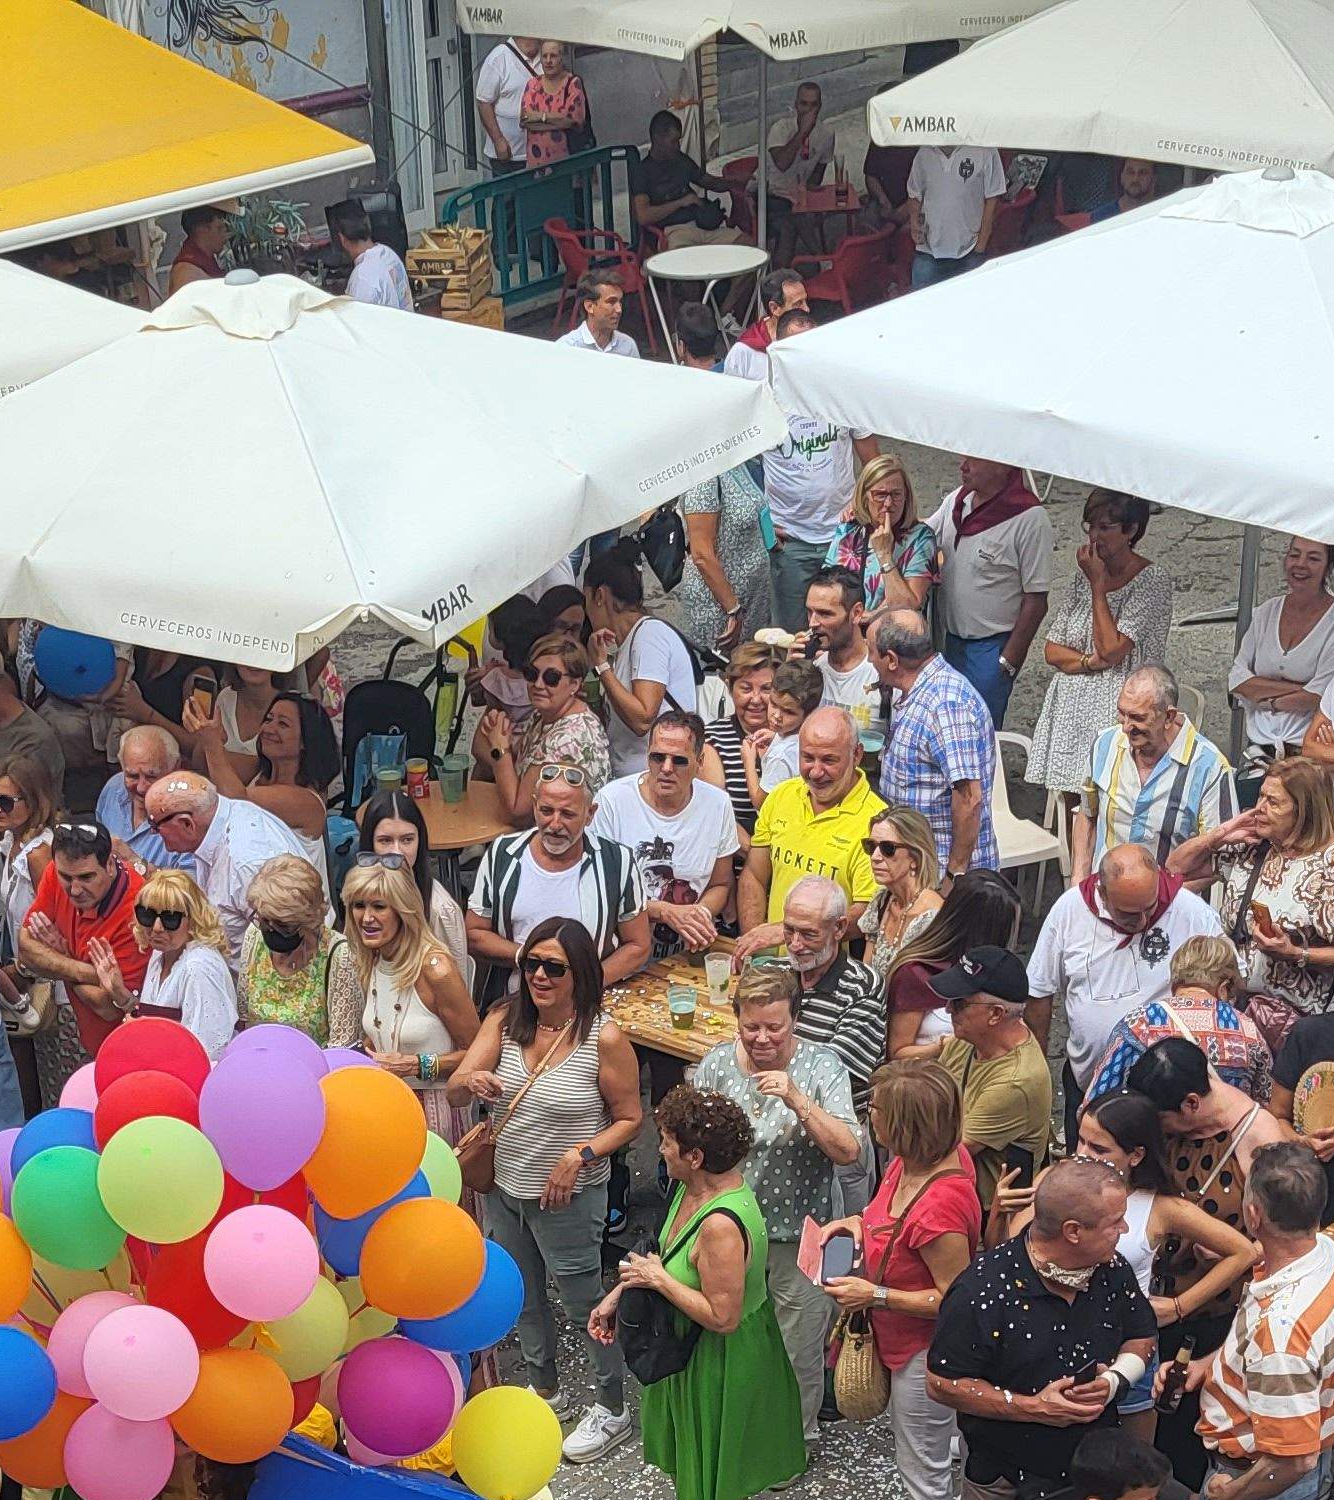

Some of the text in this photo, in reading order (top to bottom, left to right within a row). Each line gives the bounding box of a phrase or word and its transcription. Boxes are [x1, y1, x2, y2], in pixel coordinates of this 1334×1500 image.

[472, 8, 503, 24] AMBAR
[769, 29, 808, 50] MBAR
[902, 116, 956, 133] AMBAR
[1156, 139, 1316, 171] CERVECEROS INDEPENDIENTES
[637, 458, 691, 494] CERVECEROS
[689, 424, 763, 471] INDEPENDIENTES
[421, 582, 474, 625] MBAR
[120, 612, 213, 640] CERVECEROS
[217, 629, 294, 655] INDEPENDI
